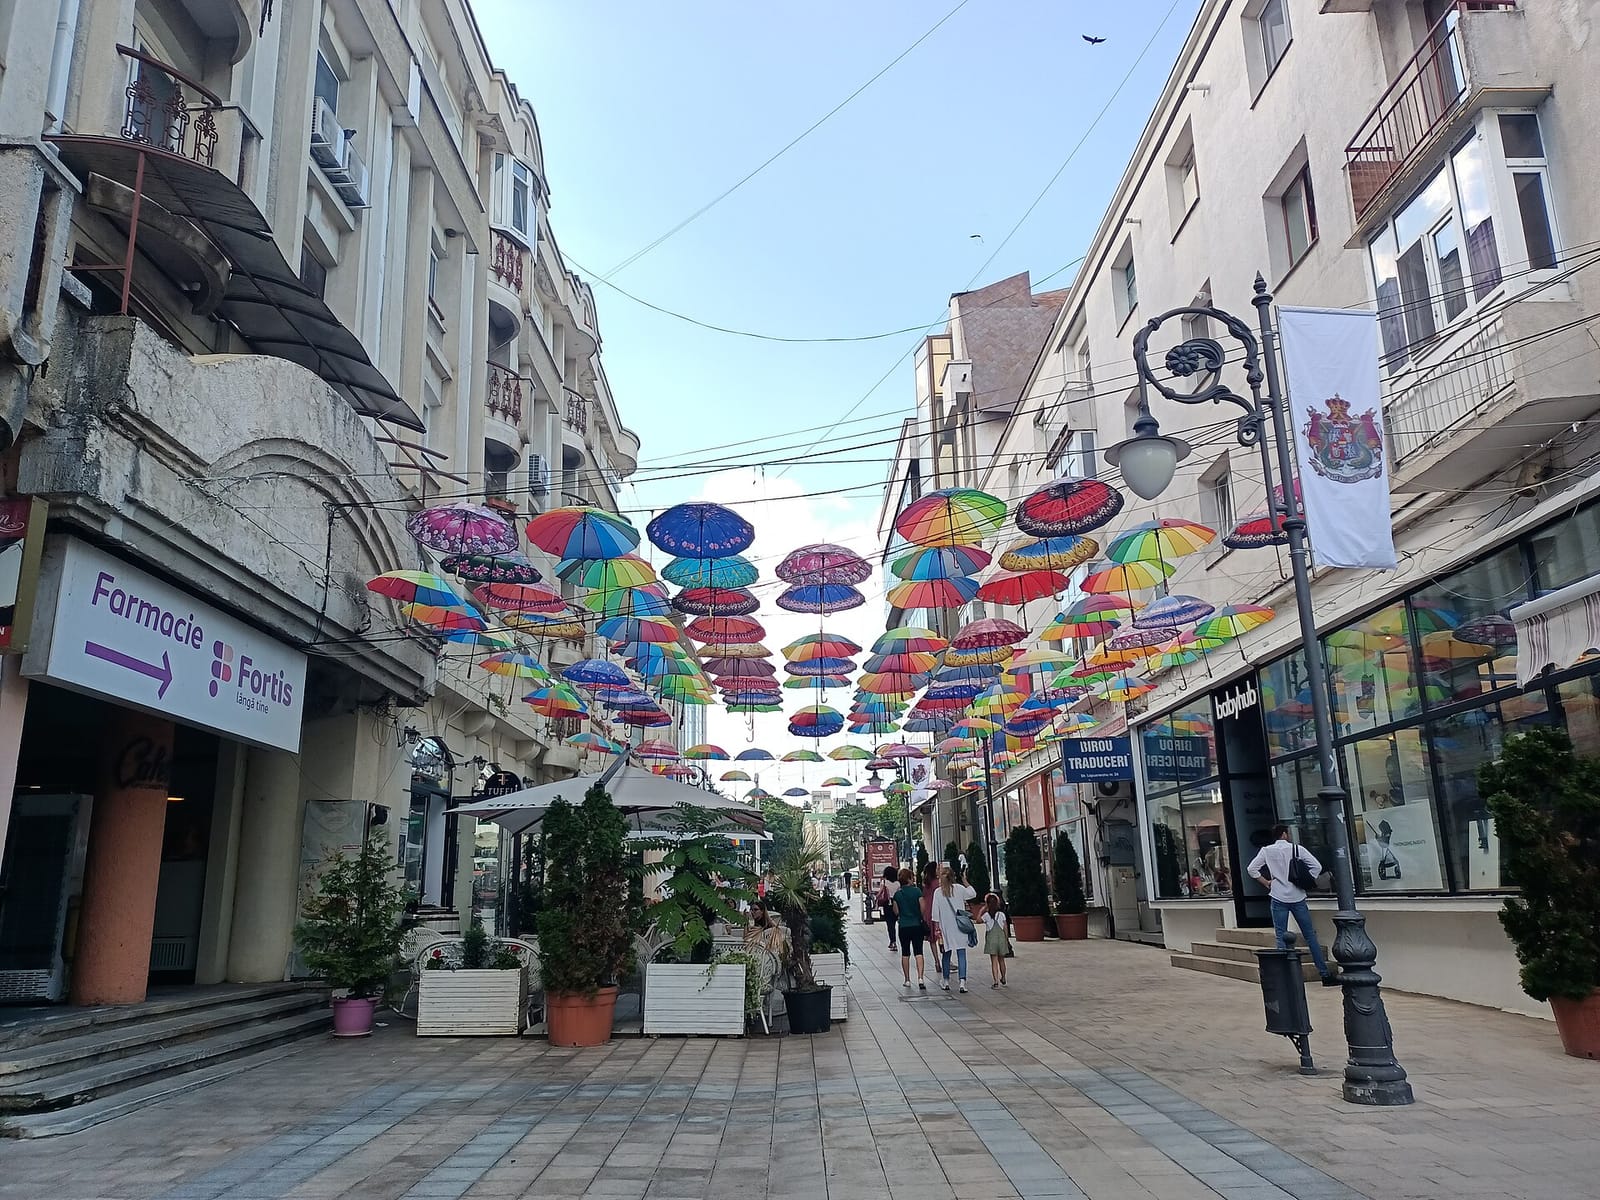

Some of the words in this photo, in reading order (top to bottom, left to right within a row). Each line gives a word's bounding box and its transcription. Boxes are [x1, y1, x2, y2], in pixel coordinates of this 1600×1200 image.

[91, 571, 204, 650] Farmacie
[238, 655, 293, 707] Fortis
[256, 700, 269, 714] tine
[1214, 680, 1257, 720] babyhub
[1080, 739, 1113, 752] BIROU
[1068, 755, 1129, 769] TRADUCERI
